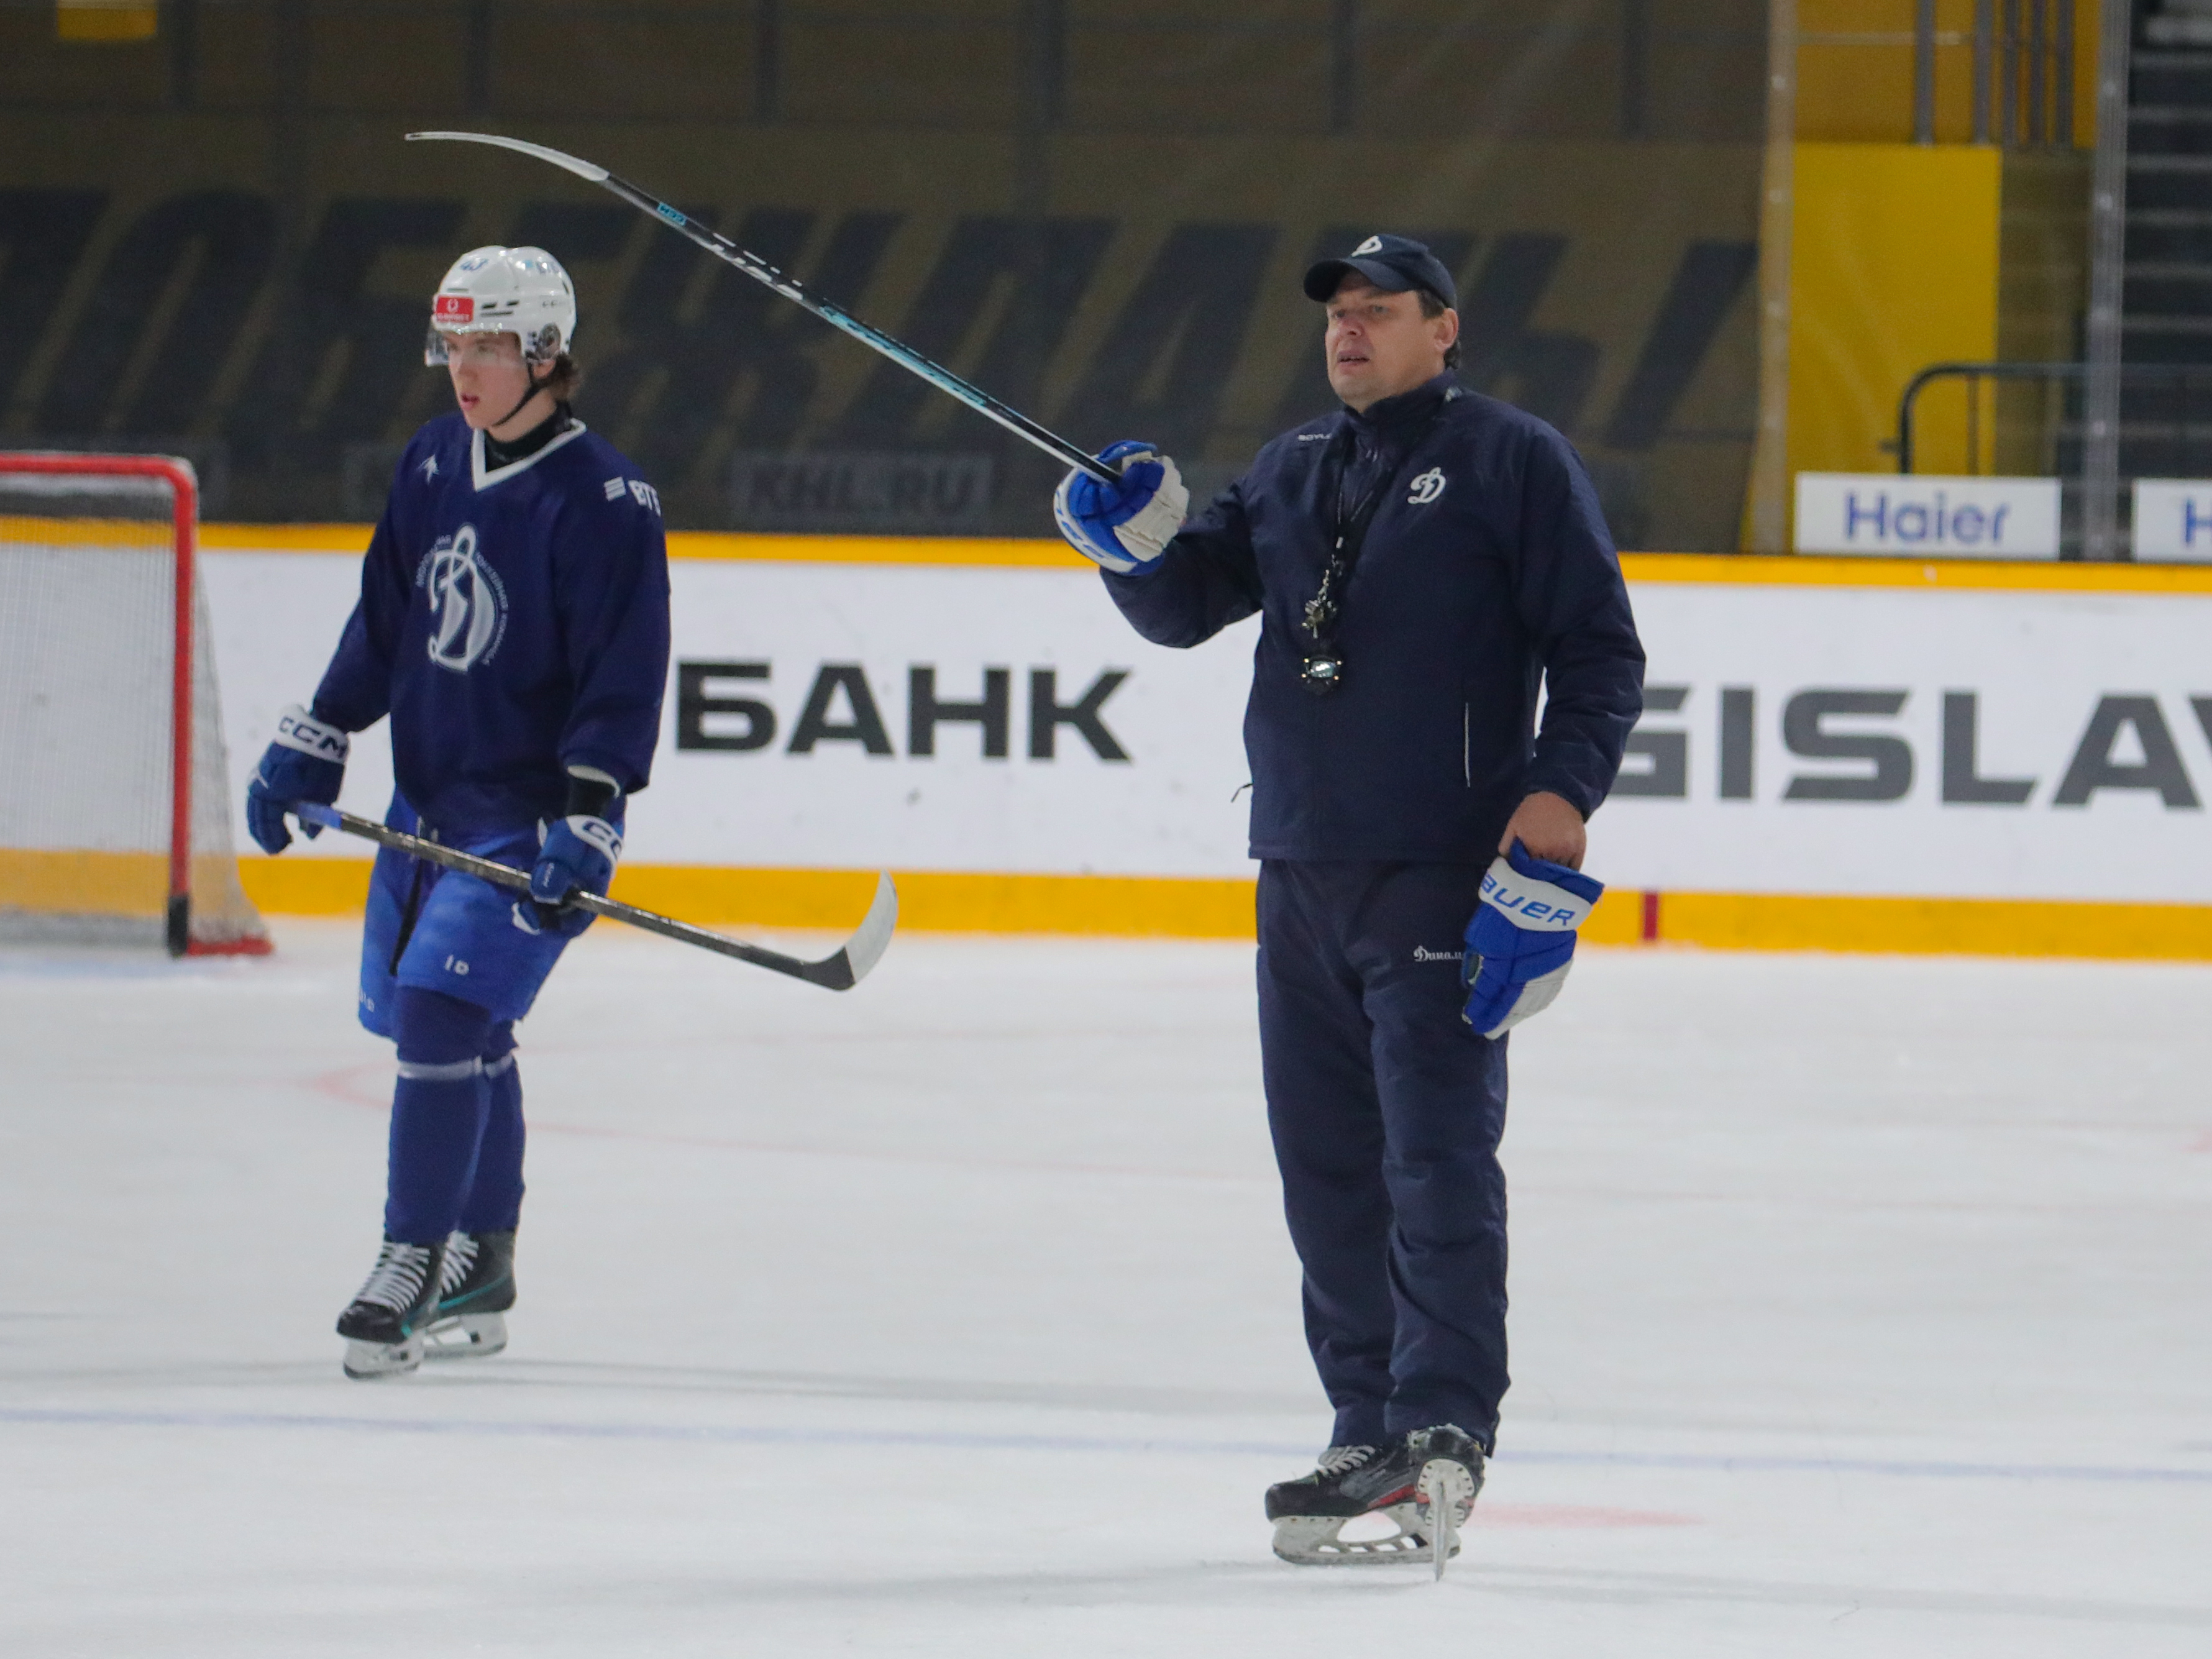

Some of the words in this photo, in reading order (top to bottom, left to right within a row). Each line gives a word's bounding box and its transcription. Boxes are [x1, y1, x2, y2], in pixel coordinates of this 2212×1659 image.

[1844, 491, 2009, 544] Haier
[675, 661, 1133, 763] БАНК
[1607, 686, 2212, 810] GISLA
